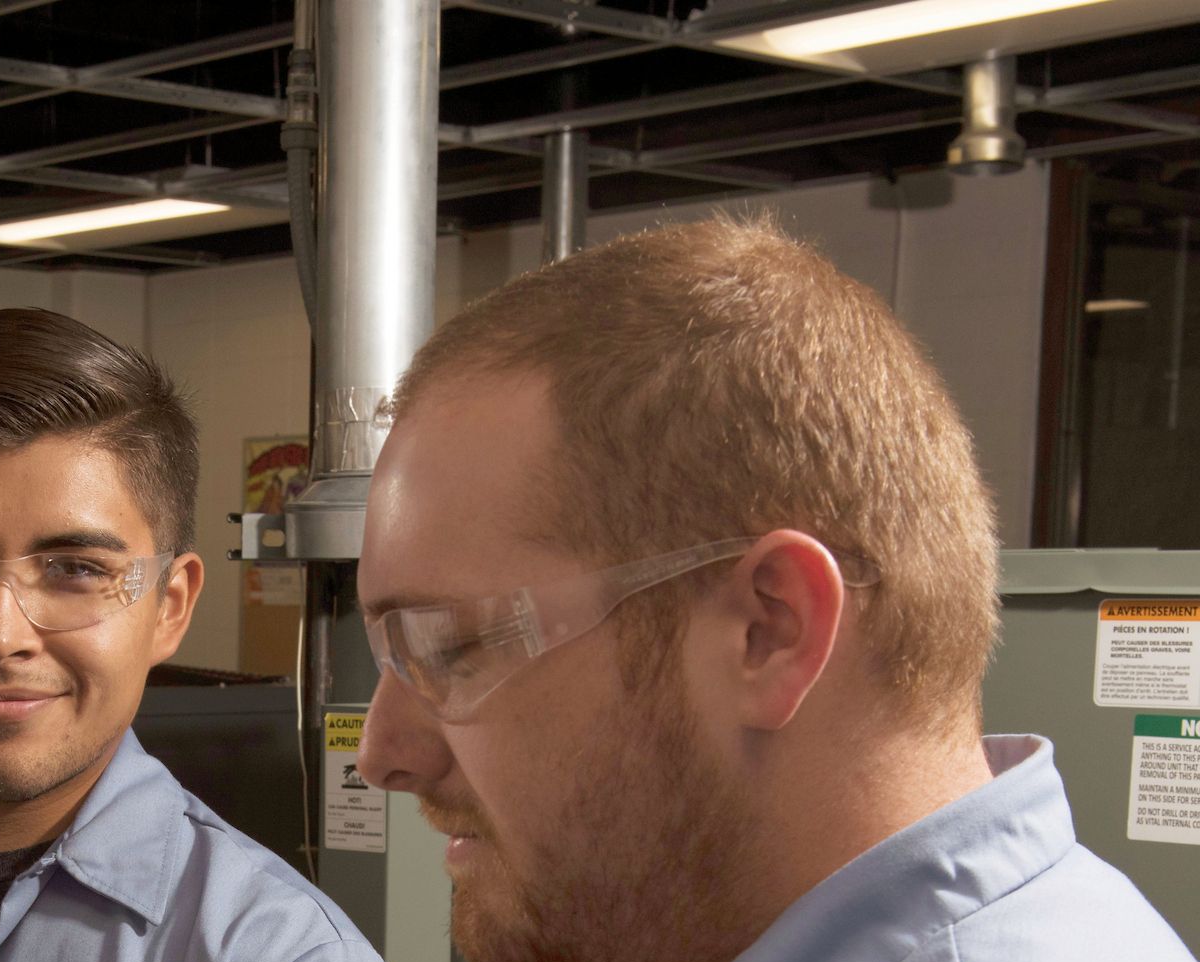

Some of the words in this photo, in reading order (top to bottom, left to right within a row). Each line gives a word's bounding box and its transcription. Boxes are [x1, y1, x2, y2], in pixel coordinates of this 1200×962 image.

[1116, 606, 1198, 617] AVERTISSEMENT
[1137, 626, 1147, 634] EN
[1148, 626, 1184, 634] ROTATION
[336, 719, 365, 728] CAUTI
[336, 736, 360, 747] PRUD
[1142, 742, 1154, 750] THIS
[1156, 742, 1162, 750] IS
[1168, 744, 1192, 752] SERVICE
[1140, 752, 1172, 762] ANYTHING
[1173, 753, 1182, 762] TO
[1182, 754, 1196, 762] THIS
[1140, 760, 1167, 770] AROUND
[1168, 762, 1182, 770] UNIT
[1184, 763, 1198, 772] THAT
[1140, 770, 1168, 779] REMOVAL
[1168, 771, 1177, 780] OF
[1178, 772, 1192, 780] THIS
[1138, 784, 1168, 793] MAINTAIN
[1176, 786, 1200, 795] MINIMU
[1138, 794, 1147, 802] ON
[1148, 794, 1162, 803] THIS
[1162, 795, 1176, 804] SIDE
[1177, 796, 1190, 804] FOR
[1190, 796, 1200, 805] SER
[1138, 808, 1146, 816] DO
[1148, 808, 1160, 816] NOT
[1162, 808, 1178, 818] DRILL
[1180, 810, 1188, 818] OR
[1136, 816, 1144, 825] AS
[1144, 818, 1160, 826] VITAL
[1162, 818, 1191, 828] INTERNAL
[1192, 820, 1200, 829] CO
